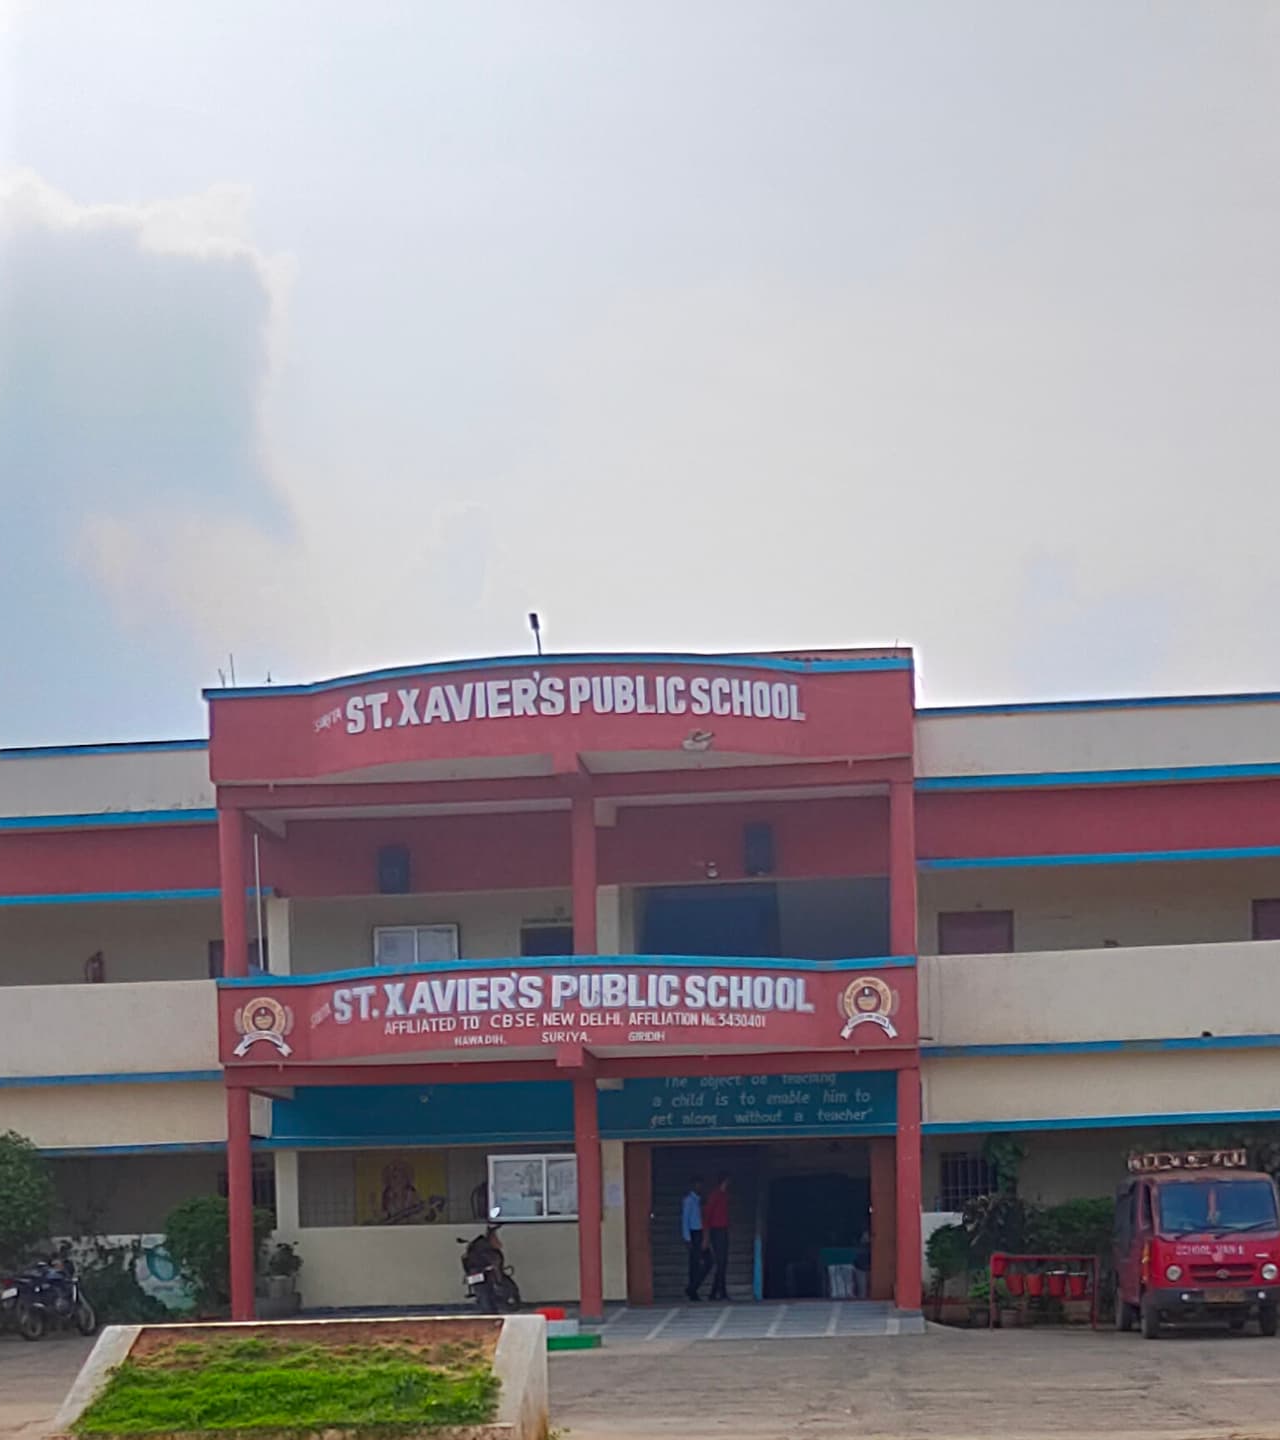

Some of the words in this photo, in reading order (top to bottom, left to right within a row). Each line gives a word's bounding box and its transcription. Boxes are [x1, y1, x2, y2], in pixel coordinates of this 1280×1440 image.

[346, 692, 392, 734] ST.
[397, 671, 565, 727] XAVIER'S
[569, 676, 686, 714] PUBLIC
[690, 677, 806, 720] SCHOOL
[333, 985, 379, 1024] ST.
[384, 972, 544, 1016] XAVIER'S
[551, 974, 680, 1009] PUBLIC
[684, 976, 815, 1013] SCHOOL
[384, 1016, 457, 1035] AFFILIATED
[461, 1015, 480, 1030] TO
[543, 1012, 574, 1026] NEW
[628, 1012, 698, 1026] AFFILIATION
[652, 1097, 662, 1107] a
[671, 1093, 705, 1108] child
[715, 1093, 729, 1107] is
[739, 1093, 757, 1106] to
[823, 1089, 848, 1104] him
[855, 1088, 871, 1103] to
[650, 1112, 673, 1129] get
[682, 1111, 718, 1128] along
[734, 1110, 783, 1124] without
[794, 1112, 804, 1123] a
